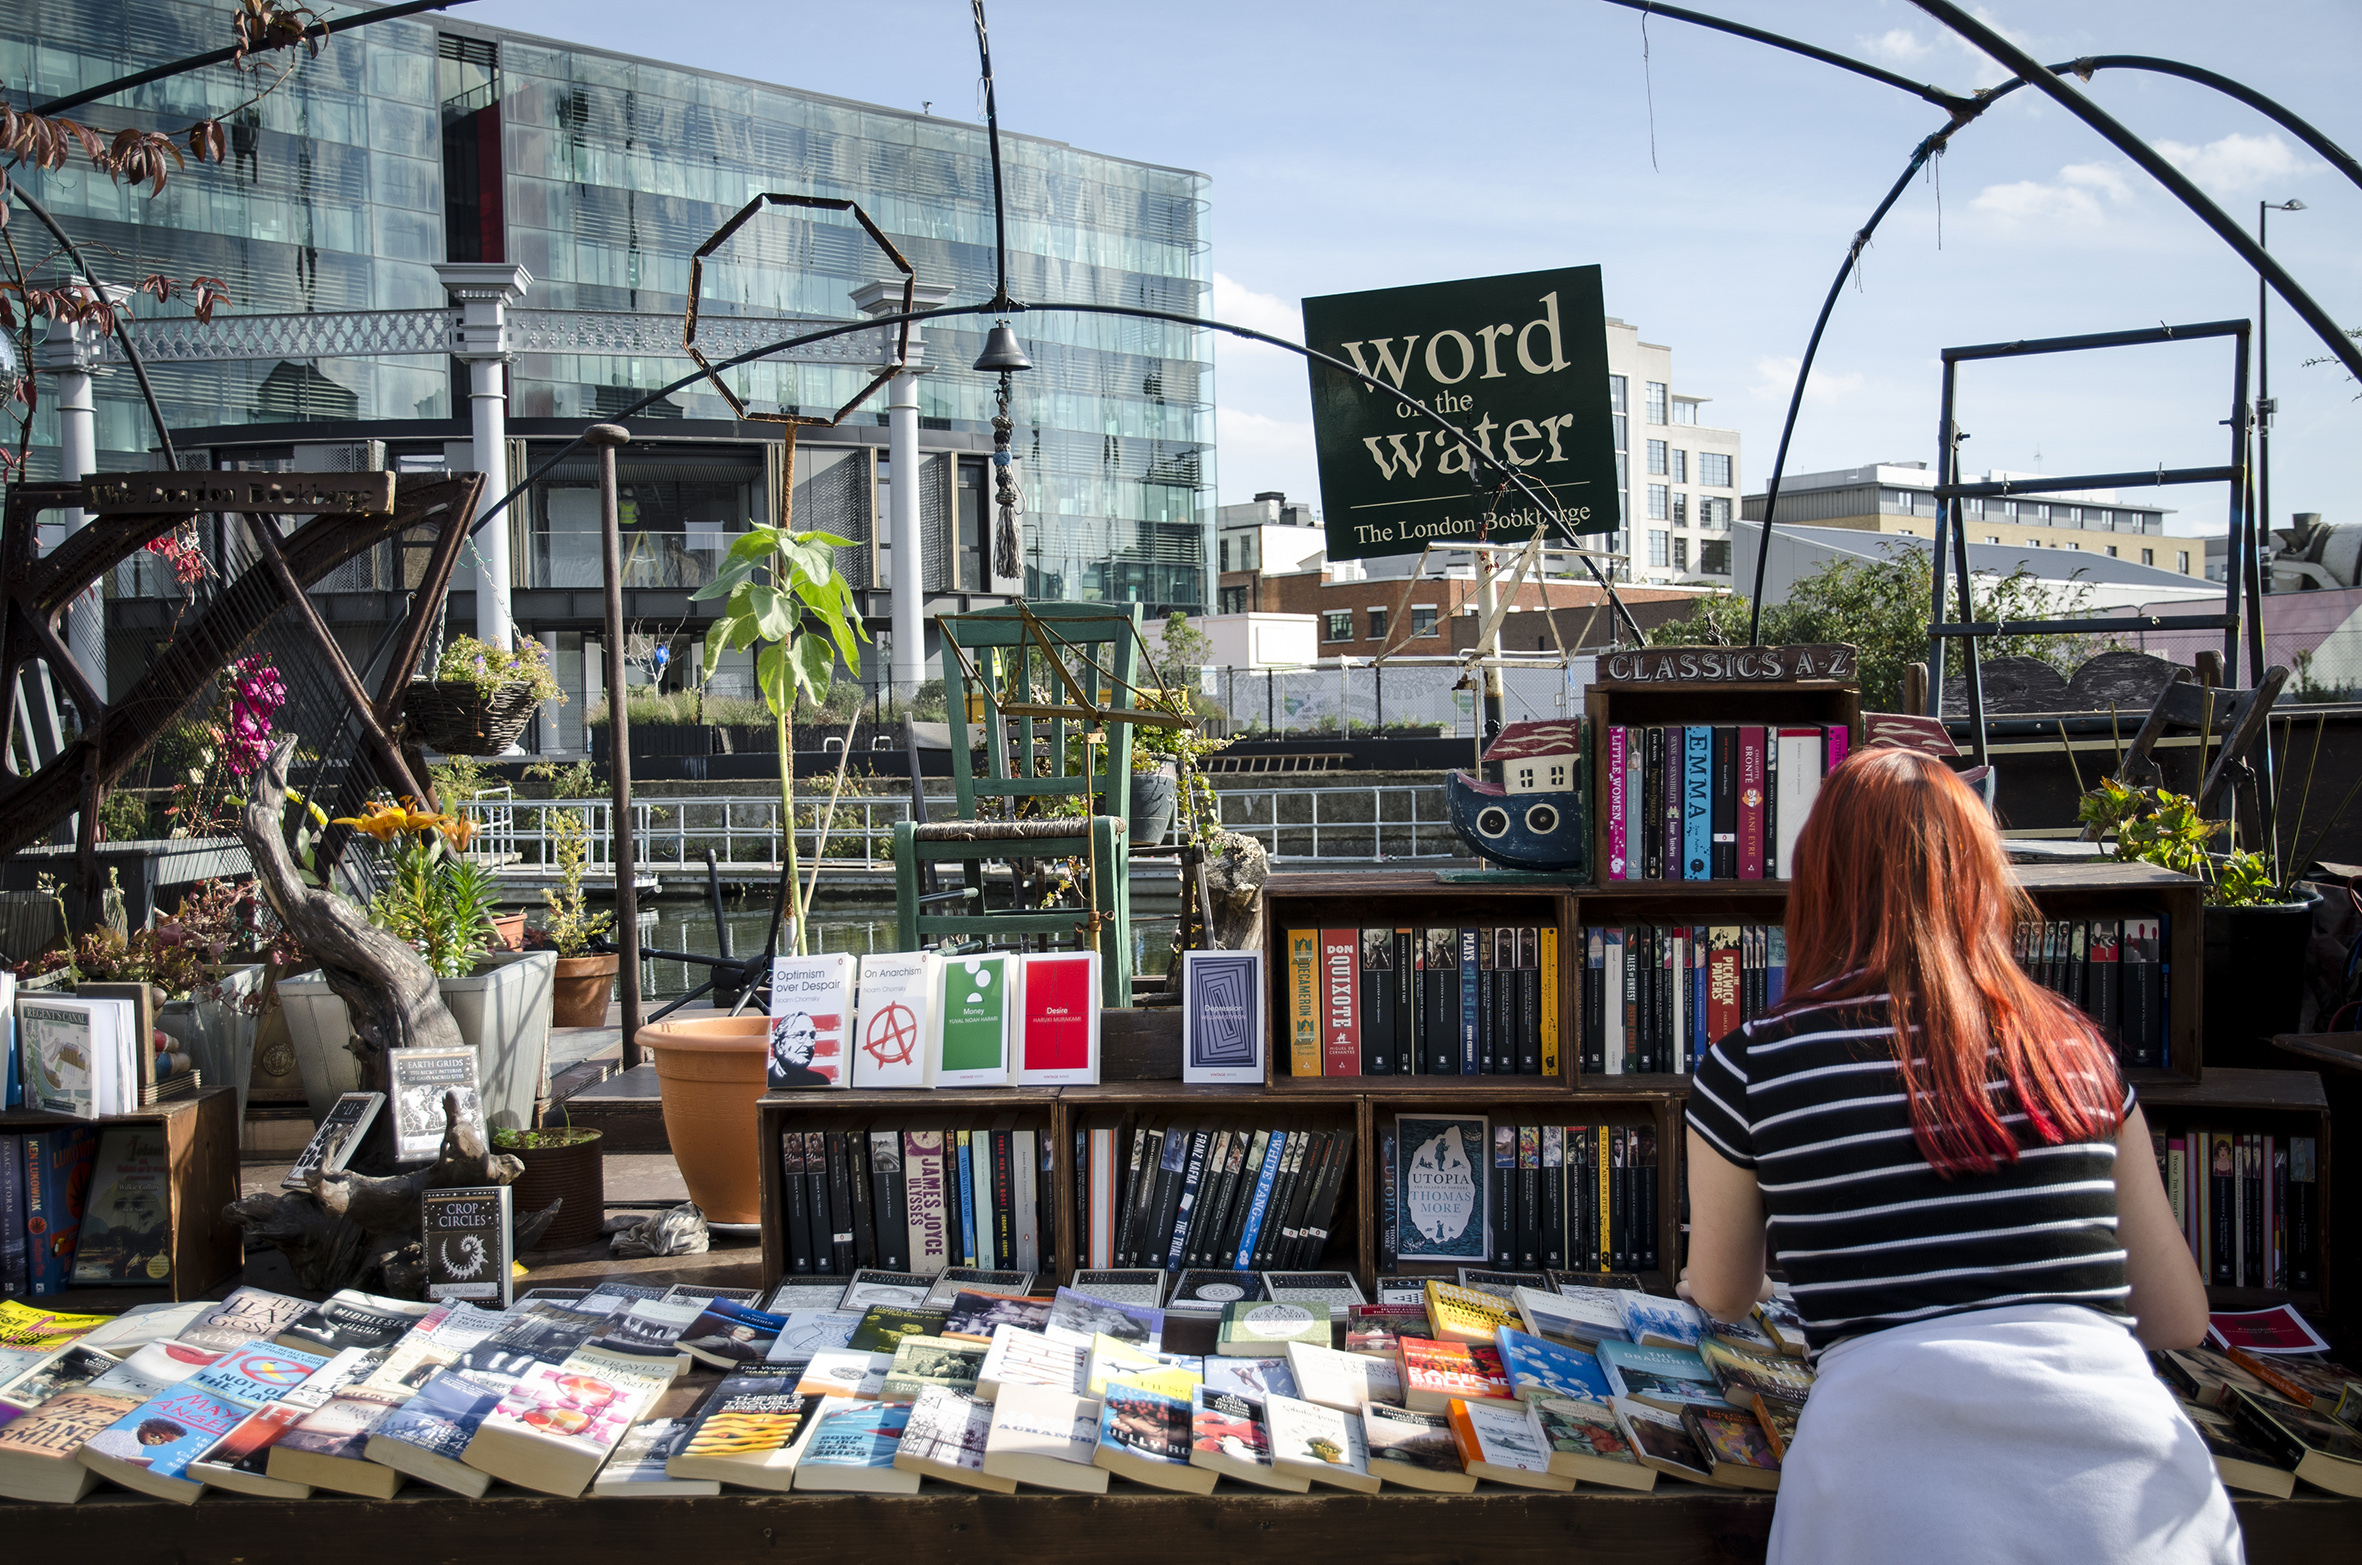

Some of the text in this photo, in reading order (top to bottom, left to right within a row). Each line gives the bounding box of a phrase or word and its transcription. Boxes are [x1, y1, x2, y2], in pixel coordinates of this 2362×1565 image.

[1342, 291, 1571, 393] word
[1396, 389, 1473, 418] on the
[1363, 412, 1574, 481] water
[91, 481, 374, 509] The London Bookbarge
[1354, 523, 1393, 544] The
[1398, 517, 1477, 540] London
[1608, 650, 1850, 680] CLASSICS A-Z
[1670, 735, 1678, 804] SENSE SENSIBILITY
[1744, 746, 1754, 784] BRONTË
[1612, 735, 1622, 821] LITTLE WOMEN
[1688, 734, 1707, 820] EMMA
[1669, 821, 1678, 858] Jane Austen
[1748, 811, 1756, 858] JANE EYRE
[1327, 945, 1354, 954] DON
[1464, 932, 1475, 961] PLAYS
[777, 970, 825, 981] Optimism
[864, 966, 922, 978] On Anarchism
[1626, 954, 1636, 1002] TALES UNREST
[1711, 963, 1723, 1000] PAPERS
[1722, 956, 1734, 1006] PICKWICK
[776, 979, 841, 993] over Despair
[882, 986, 907, 994] Chomsky
[1297, 962, 1312, 1017] DECAMERON
[1327, 955, 1352, 1028] QUIXOTE
[794, 995, 821, 1004] Chomsky
[1204, 1004, 1243, 1013] Depression
[27, 1007, 64, 1021] REGENT'S
[64, 1012, 88, 1024] CANAL
[963, 1008, 985, 1016] Money
[1627, 1004, 1636, 1054] JOSEPH CONRAD
[408, 1059, 464, 1069] EARTH GRIDS
[1601, 1132, 1608, 1142] DR
[1186, 1132, 1207, 1185] FRANZ KAFKA
[3, 1141, 13, 1213] ISAAC'S STORM
[28, 1140, 42, 1211] KEN LUKOWIAK
[1252, 1139, 1282, 1217] WHITE FANG
[1413, 1173, 1470, 1185] UTOPIA
[960, 1157, 970, 1218] WASHINGTON SQUARE
[1384, 1165, 1395, 1223] UTOPIA
[1410, 1190, 1472, 1202] THOMAS
[1601, 1185, 1608, 1195] MR
[446, 1203, 479, 1215] CROP
[908, 1178, 924, 1226] ULYSSES
[920, 1158, 943, 1256] JAMES JOYCE
[1420, 1202, 1461, 1213] MORE
[439, 1215, 486, 1227] CIRCLES
[1169, 1220, 1188, 1257] THE TRIAL
[1064, 1290, 1161, 1314] EDWARD UPWARD
[1436, 1289, 1506, 1310] WHEEN
[1440, 1295, 1482, 1309] HOW
[334, 1308, 411, 1328] MIDDLESEX
[740, 1313, 775, 1327] CANDIDE
[906, 1308, 943, 1316] FUGARD
[1443, 1308, 1510, 1326] JUMBO
[581, 1354, 666, 1373] BETRAYED
[1624, 1352, 1703, 1366] DRAGONFLY
[1648, 1351, 1673, 1360] THE
[199, 1373, 235, 1392] THE
[219, 1372, 261, 1391] NOT
[1409, 1375, 1490, 1392] BULLS
[722, 1403, 801, 1411] BREWING
[1283, 1404, 1341, 1425] Shakespeare
[1494, 1412, 1521, 1421] Island
[25, 1420, 99, 1440] JANE
[1492, 1416, 1516, 1424] Sheep
[1107, 1429, 1161, 1449] JELLY
